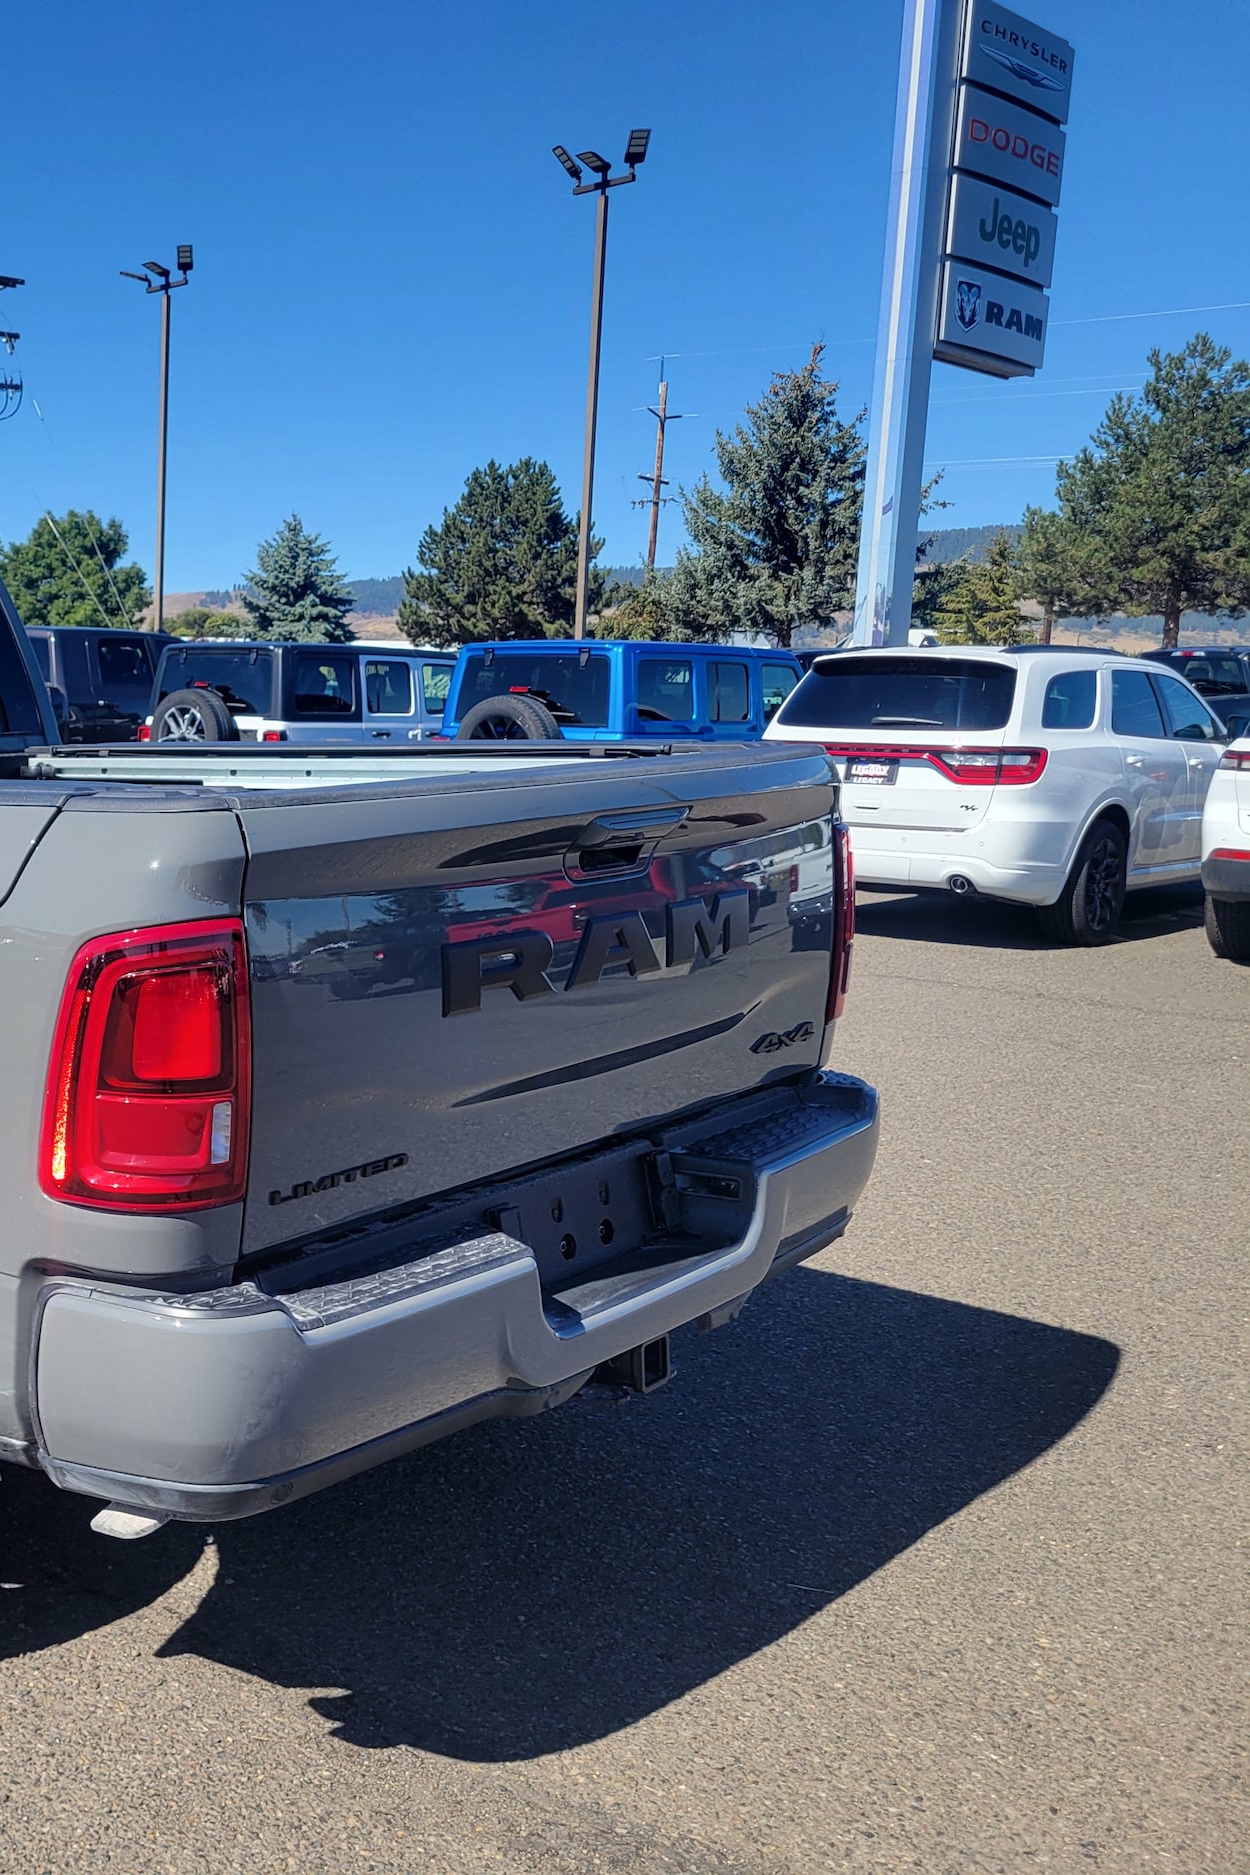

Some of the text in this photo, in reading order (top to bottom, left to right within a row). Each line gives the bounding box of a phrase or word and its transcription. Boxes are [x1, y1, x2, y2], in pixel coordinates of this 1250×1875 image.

[980, 19, 1068, 75] CHRYSLER
[968, 118, 1059, 178] DODGE
[979, 198, 1040, 268] Jeep
[985, 300, 1043, 341] RAM
[441, 888, 750, 1018] RAM
[268, 1152, 410, 1206] LIMITED
